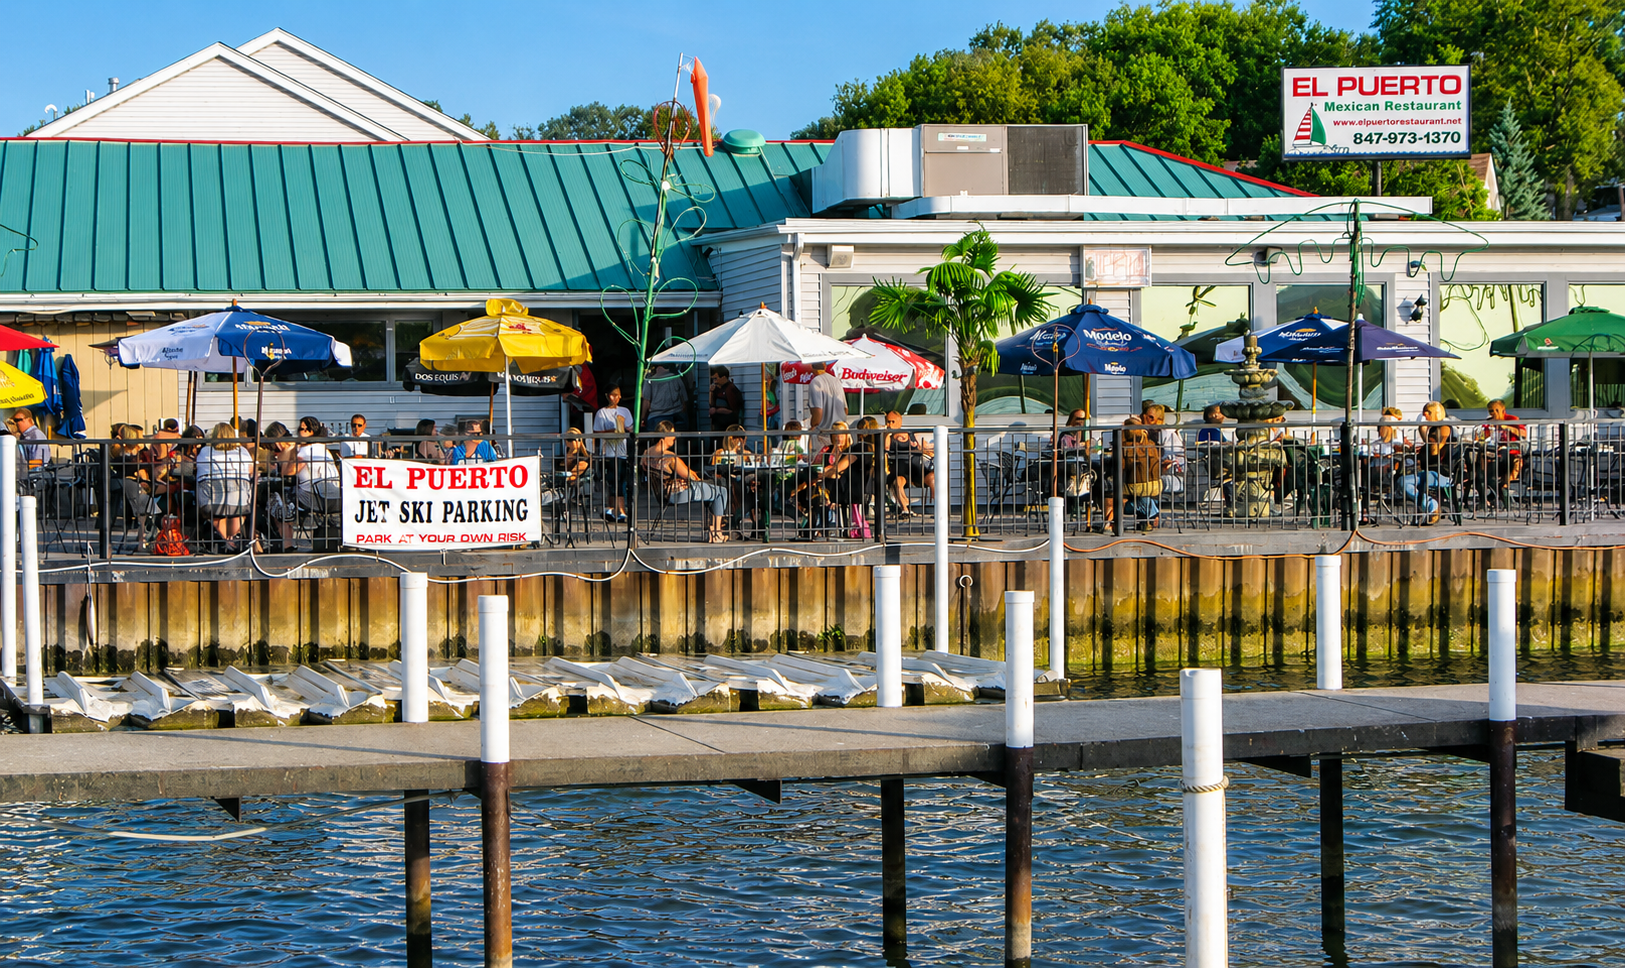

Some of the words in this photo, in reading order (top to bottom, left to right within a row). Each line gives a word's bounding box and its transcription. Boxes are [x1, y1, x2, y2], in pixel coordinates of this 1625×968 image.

[1292, 76, 1329, 97] EL
[1337, 74, 1462, 97] PUERTO
[1324, 101, 1380, 112] Mexican
[1384, 100, 1462, 111] Restaurant
[1333, 117, 1462, 127] www.elpuertorestaurant.net
[1353, 131, 1461, 145] 847-973-1370
[1083, 328, 1132, 341] Modelo
[415, 373, 434, 382] DOS
[434, 373, 459, 384] EQUIS
[841, 367, 908, 383] Budweiser
[353, 466, 393, 489] EL
[406, 464, 529, 490] PUERTO
[355, 500, 390, 524] JET
[399, 500, 434, 524] SKI
[442, 498, 529, 523] PARKING
[356, 534, 392, 544] PARK
[398, 534, 415, 544] AT
[418, 533, 455, 544] YOUR
[460, 533, 494, 543] OWN
[498, 532, 527, 542] RISK
